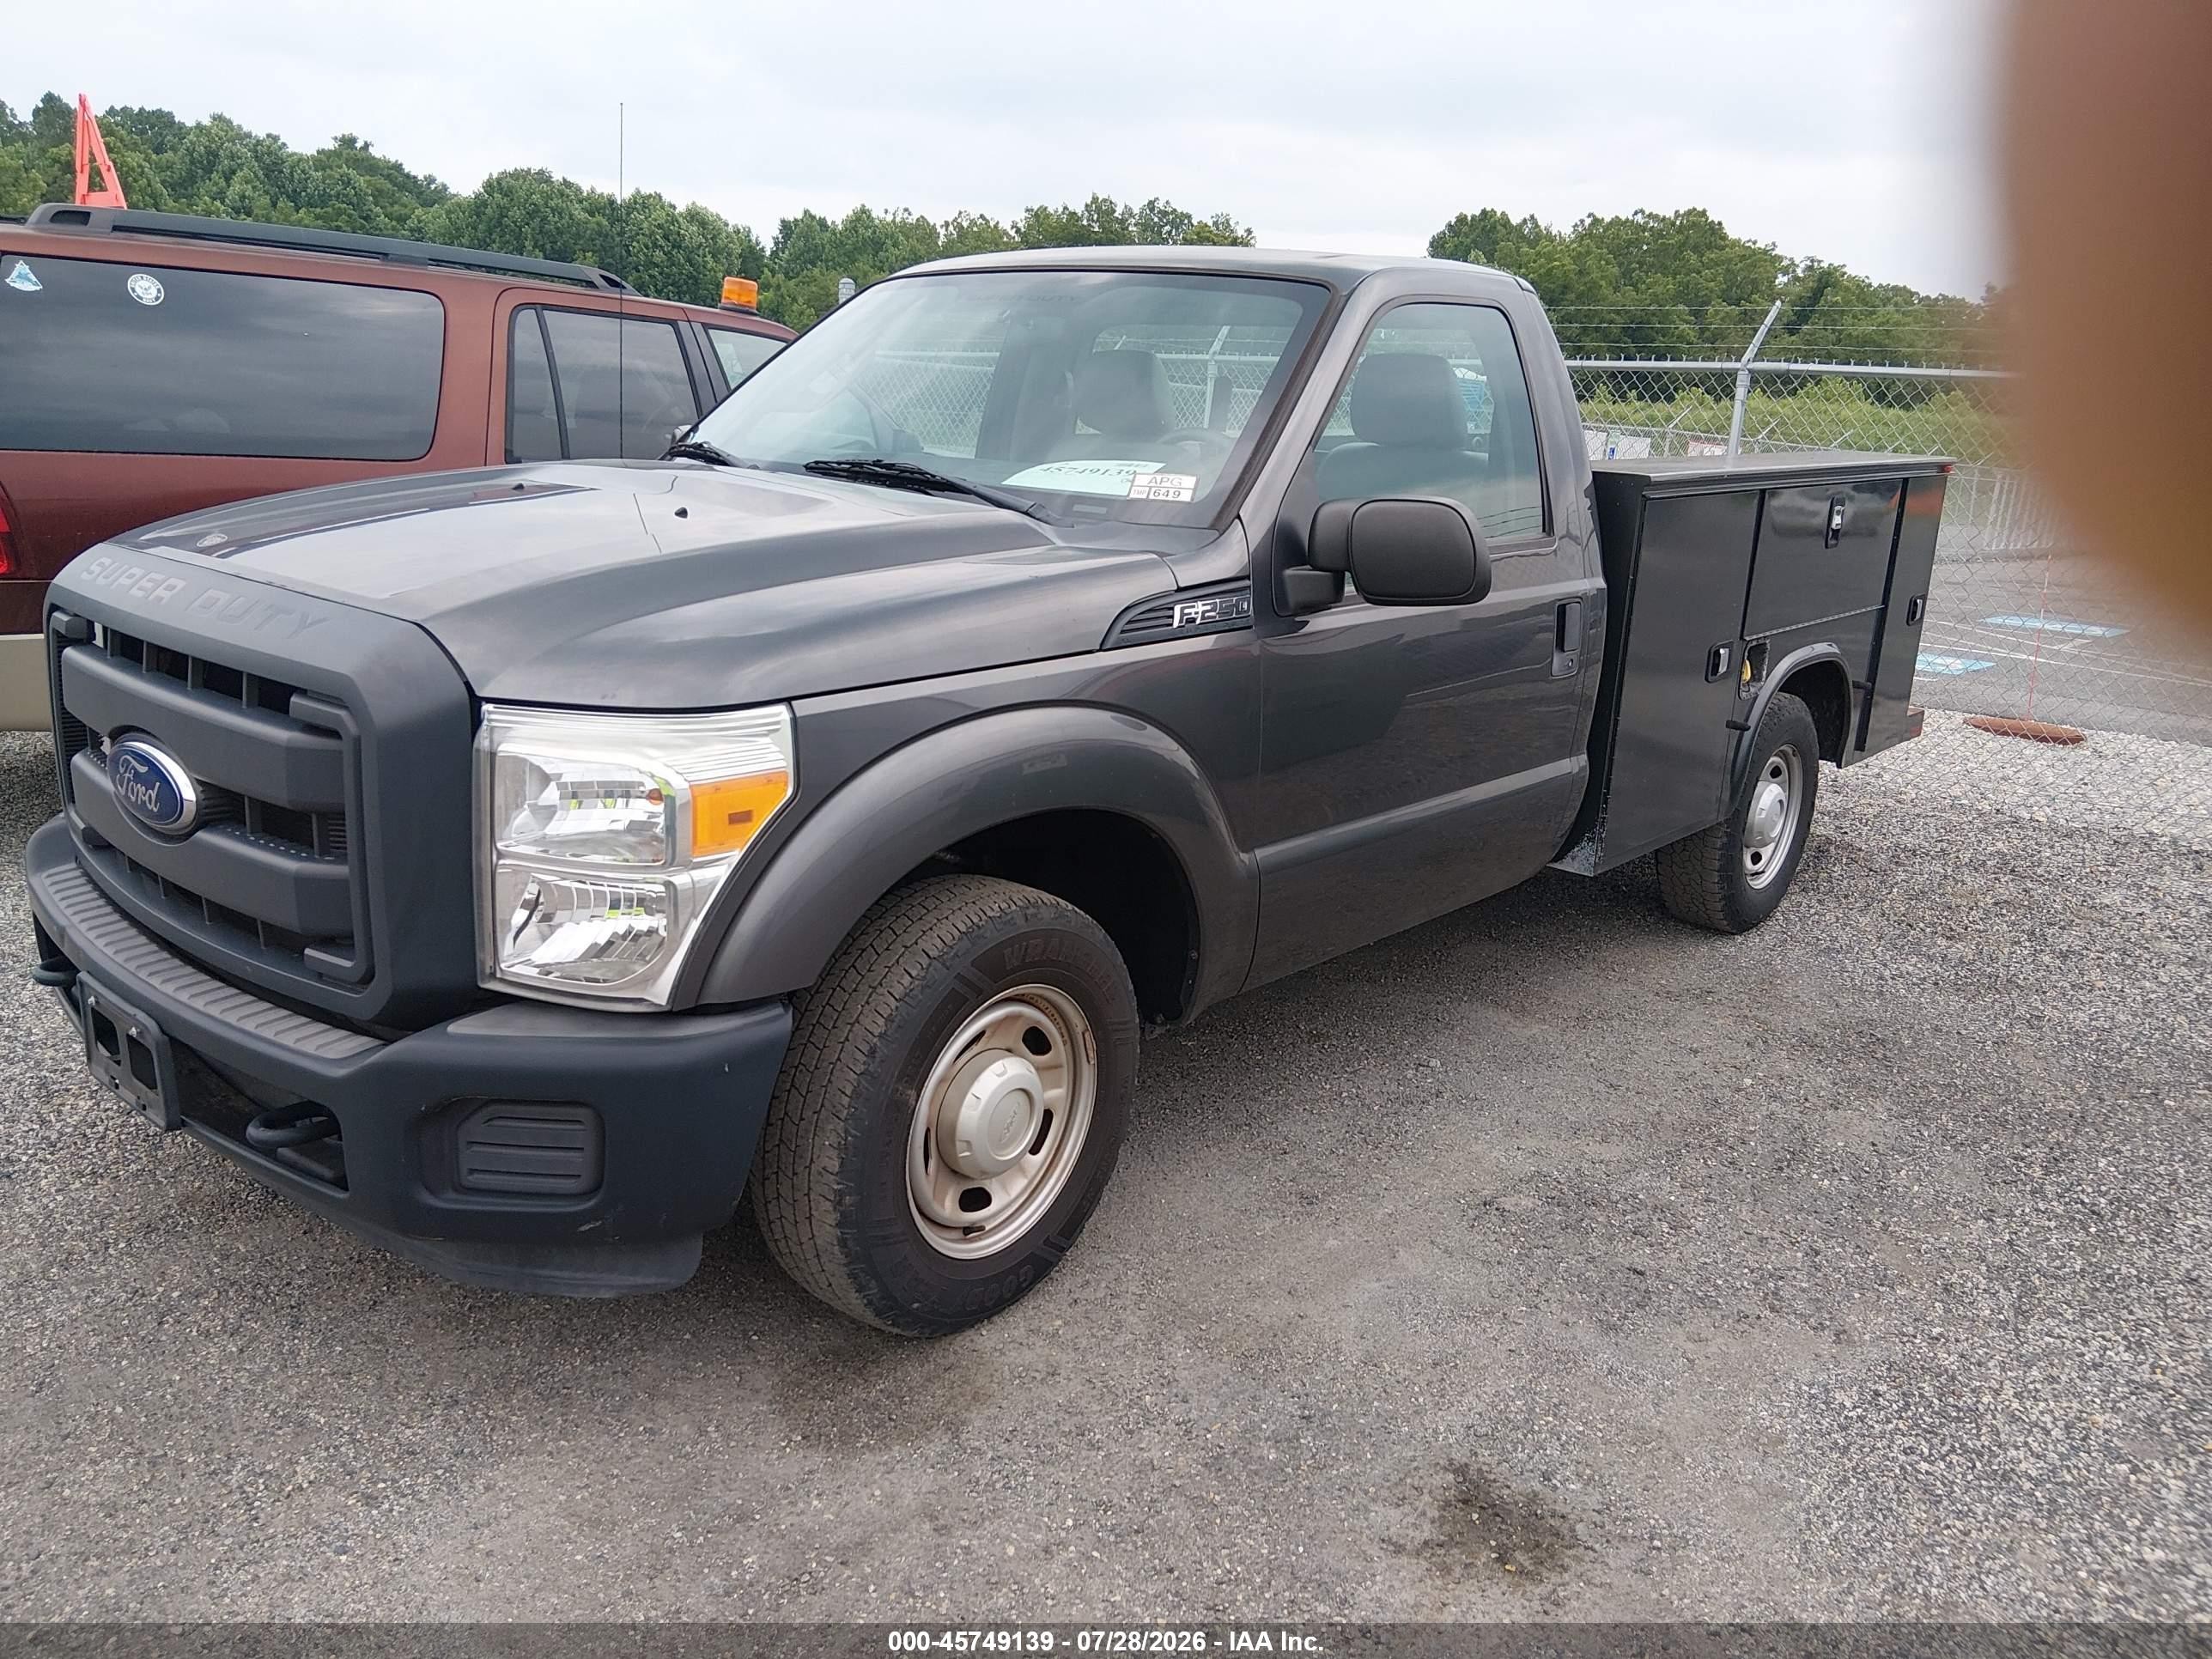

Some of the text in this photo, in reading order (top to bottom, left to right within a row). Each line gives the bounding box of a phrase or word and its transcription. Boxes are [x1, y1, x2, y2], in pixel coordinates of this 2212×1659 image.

[1147, 476, 1182, 487] APG
[1152, 489, 1182, 499] 649
[81, 556, 331, 640] SUPER DUTY
[116, 755, 161, 813] Ford
